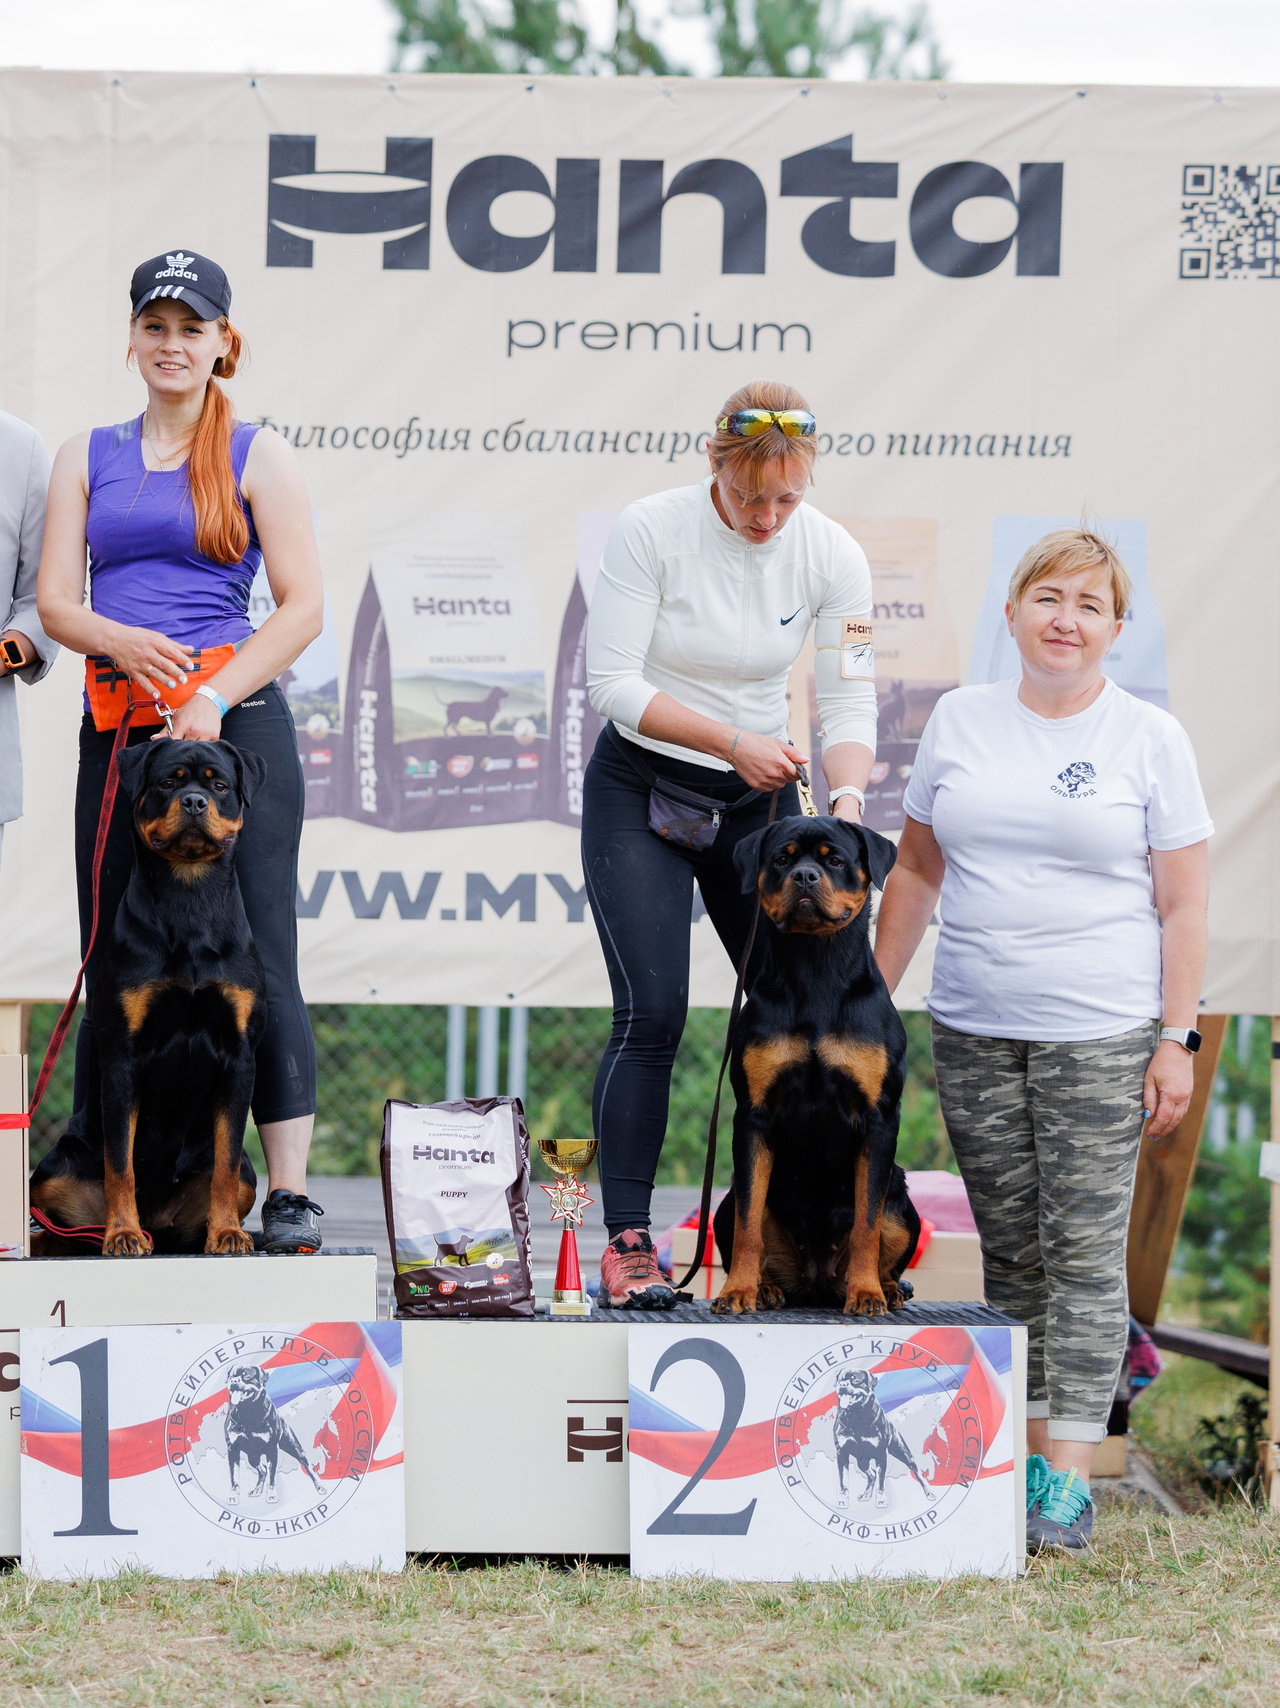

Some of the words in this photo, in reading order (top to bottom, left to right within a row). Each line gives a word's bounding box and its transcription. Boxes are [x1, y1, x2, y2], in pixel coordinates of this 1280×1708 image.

[266, 133, 1064, 278] Hanta
[154, 267, 199, 282] adidas
[507, 311, 812, 358] premium
[885, 430, 1073, 459] питания
[412, 596, 511, 616] Hanta
[240, 699, 267, 709] Reebok
[359, 689, 379, 813] Hanta
[1050, 785, 1097, 799] ОЛЬБУРД
[413, 1145, 496, 1165] Hanta
[440, 1190, 469, 1198] PUPPY
[170, 1338, 247, 1487] РОТВЕЙЛЕР
[261, 1335, 331, 1368] КЛУБ
[334, 1371, 374, 1484] РОССИИ
[776, 1343, 856, 1489] РОТВЕЙЛЕР
[869, 1338, 941, 1374] КЛУБ
[945, 1376, 982, 1491] РОССИИ
[48, 1337, 139, 1538] 1
[645, 1337, 758, 1536] 2
[216, 1502, 331, 1538] РКФ-НКПР
[825, 1509, 940, 1541] РКФ-НКПР
